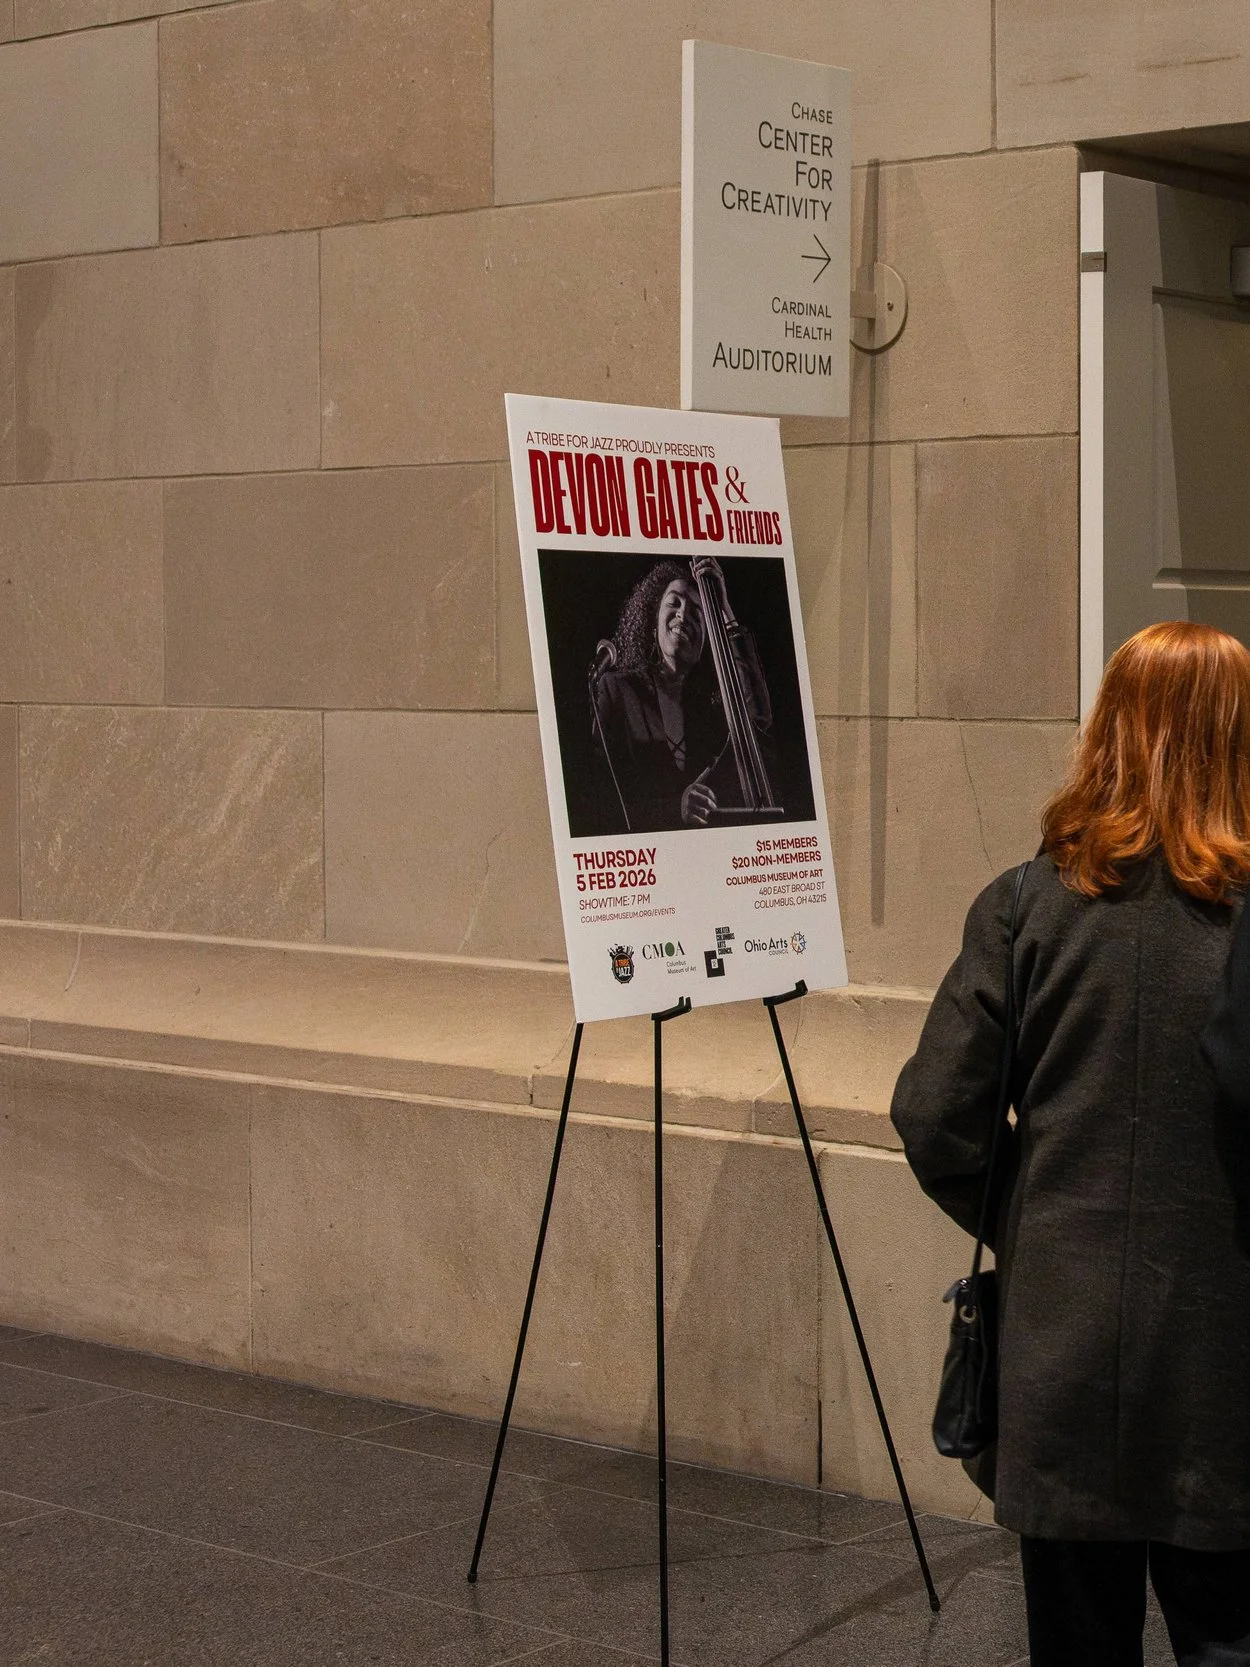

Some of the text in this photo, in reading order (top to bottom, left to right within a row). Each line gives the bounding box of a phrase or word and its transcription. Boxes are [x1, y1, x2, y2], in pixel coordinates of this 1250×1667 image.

[791, 102, 833, 125] CHASE
[758, 121, 833, 158] CENTER
[795, 160, 833, 192] FOR
[721, 181, 832, 222] CREATIVITY
[771, 296, 832, 319] CARDINAL
[784, 320, 832, 342] HEALTH
[712, 341, 832, 376] AUDITORIUM
[526, 431, 716, 459] A TRIBE FOR JAZZ PROUDLY PRESENTS
[528, 449, 750, 542] DEVON GATES &
[726, 509, 783, 545] FRIENDS
[756, 836, 818, 853] $15 MEMBERS
[573, 848, 656, 870] THURSDAY
[732, 851, 822, 870] $20 NON-MEMBERS
[576, 868, 656, 892] 5 FEB 2026
[726, 869, 823, 886] COLUMBUS MUSEUM OF ART
[759, 881, 825, 896] 480 EAST BROAD ST
[579, 894, 650, 910] SHOWTIME: 7 PM
[754, 893, 827, 909] COLUMBUS, OH 43215
[581, 907, 675, 923] COLUMBUSMUSEUM.ORG/EVENTS
[744, 937, 788, 953] Ohio Arts
